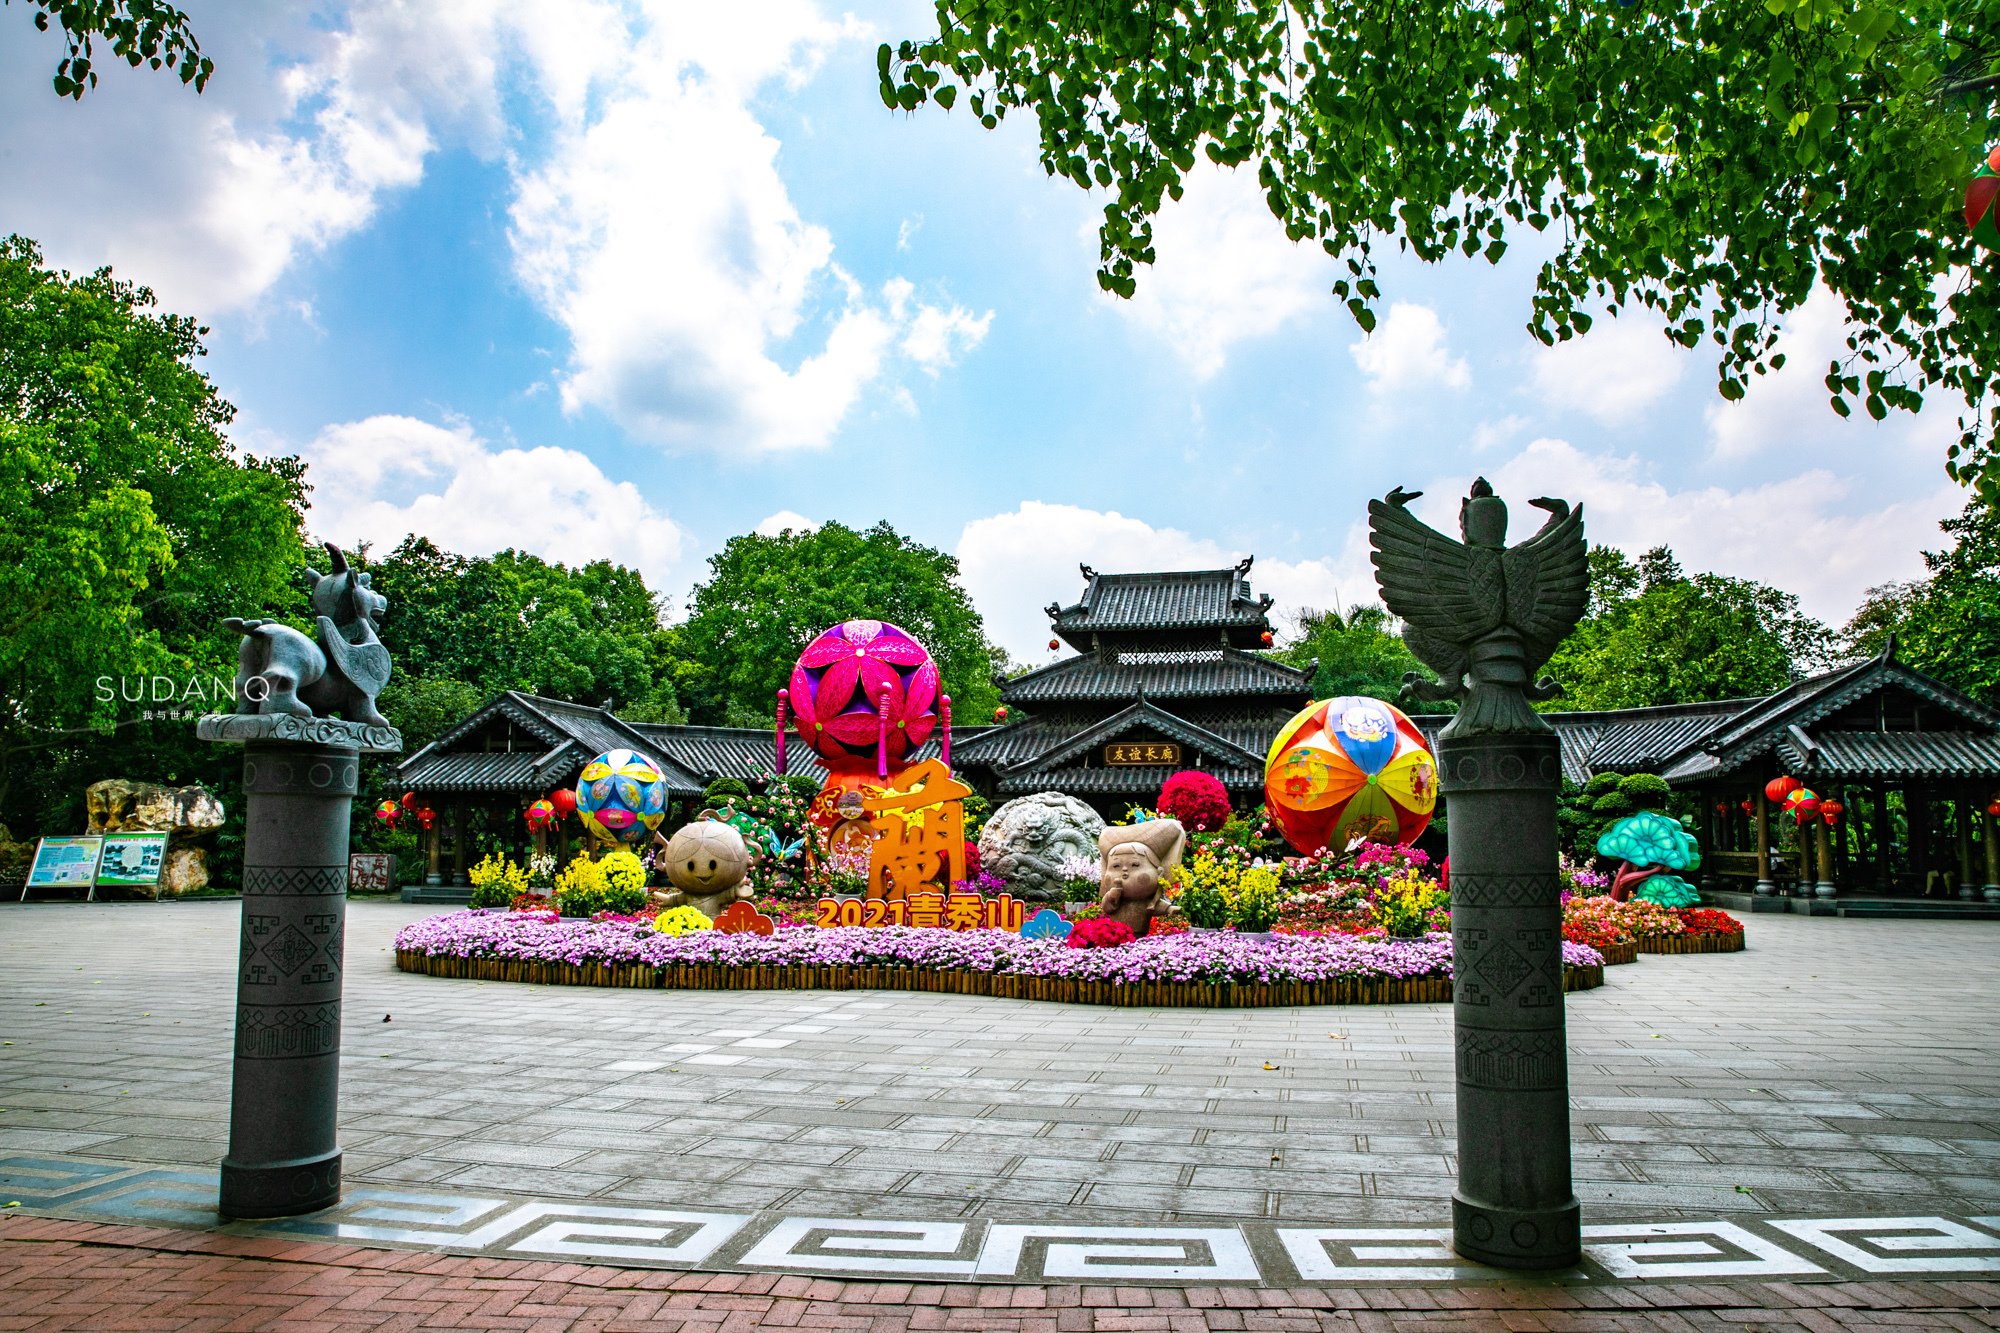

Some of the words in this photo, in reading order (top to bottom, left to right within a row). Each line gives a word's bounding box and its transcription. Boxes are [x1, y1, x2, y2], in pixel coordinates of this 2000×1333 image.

[1112, 745, 1174, 763] 友谊长廊
[816, 892, 1025, 933] 2021青秀山
